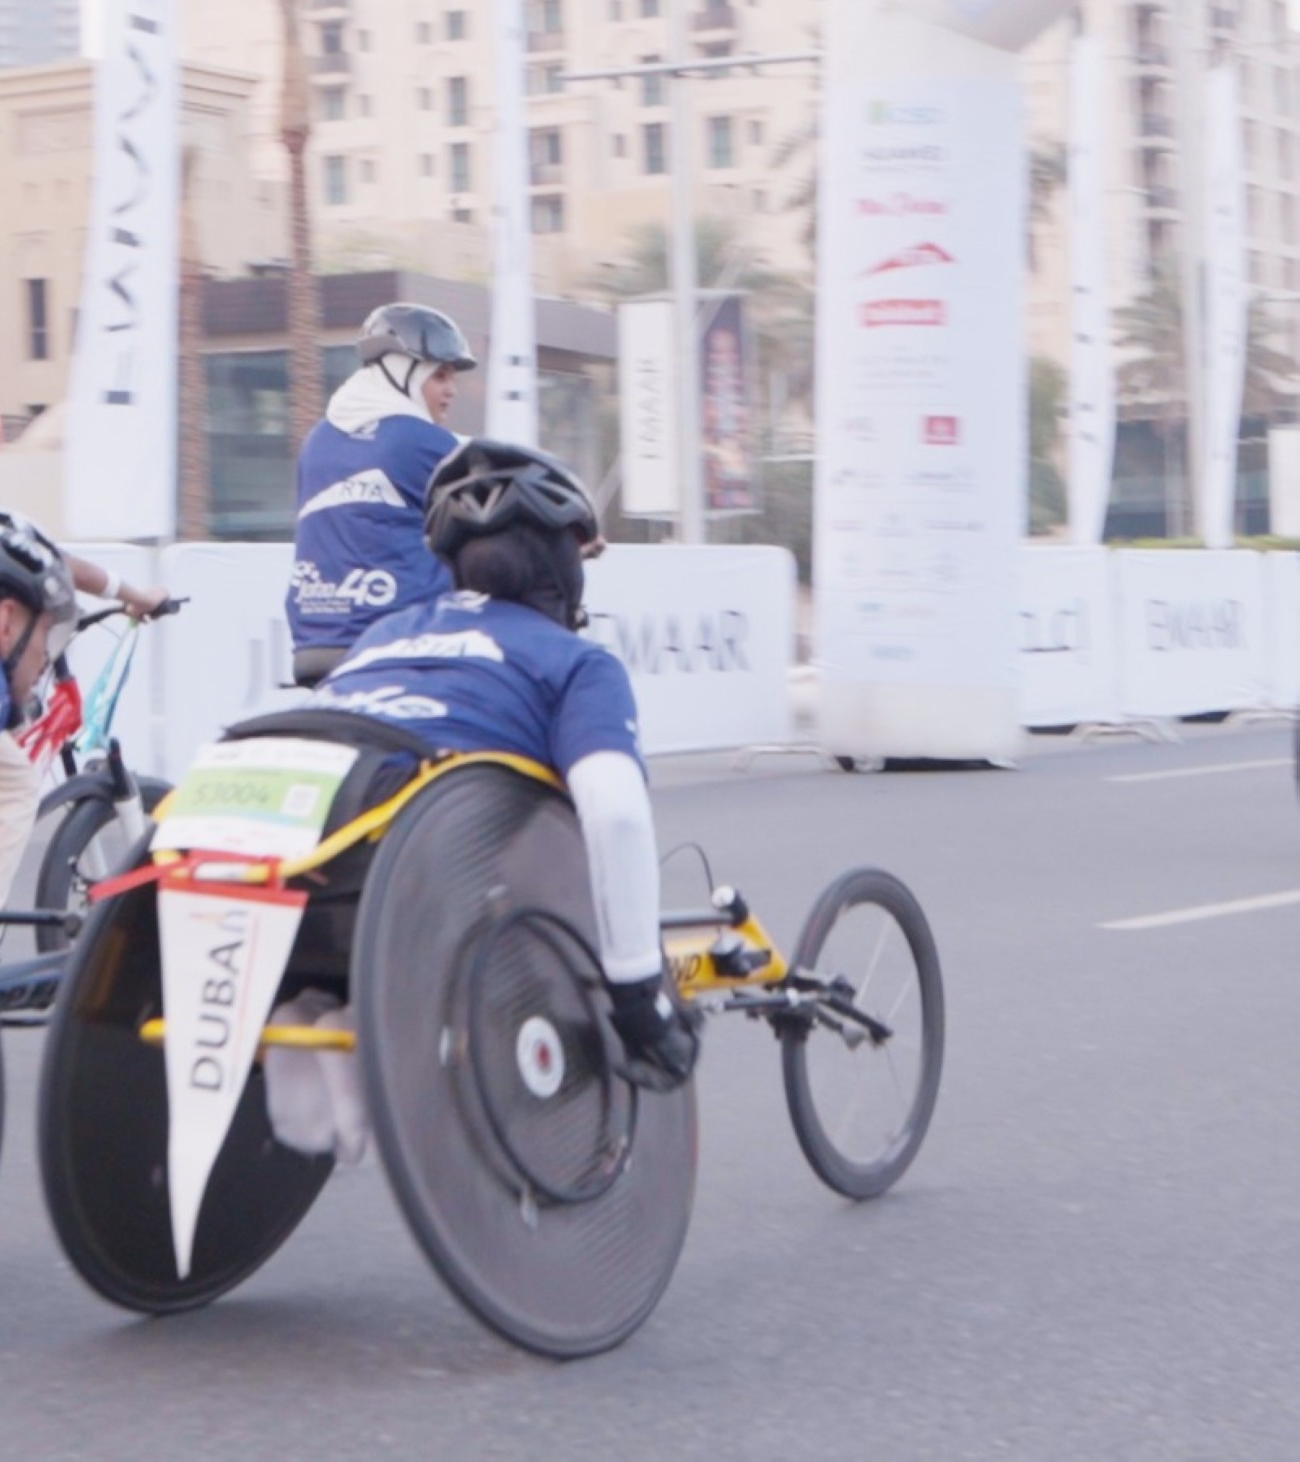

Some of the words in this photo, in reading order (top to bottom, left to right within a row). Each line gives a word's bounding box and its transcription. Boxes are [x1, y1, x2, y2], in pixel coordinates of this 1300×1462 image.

[335, 568, 398, 606] 40
[586, 608, 752, 675] MAAR
[191, 783, 269, 805] 53004
